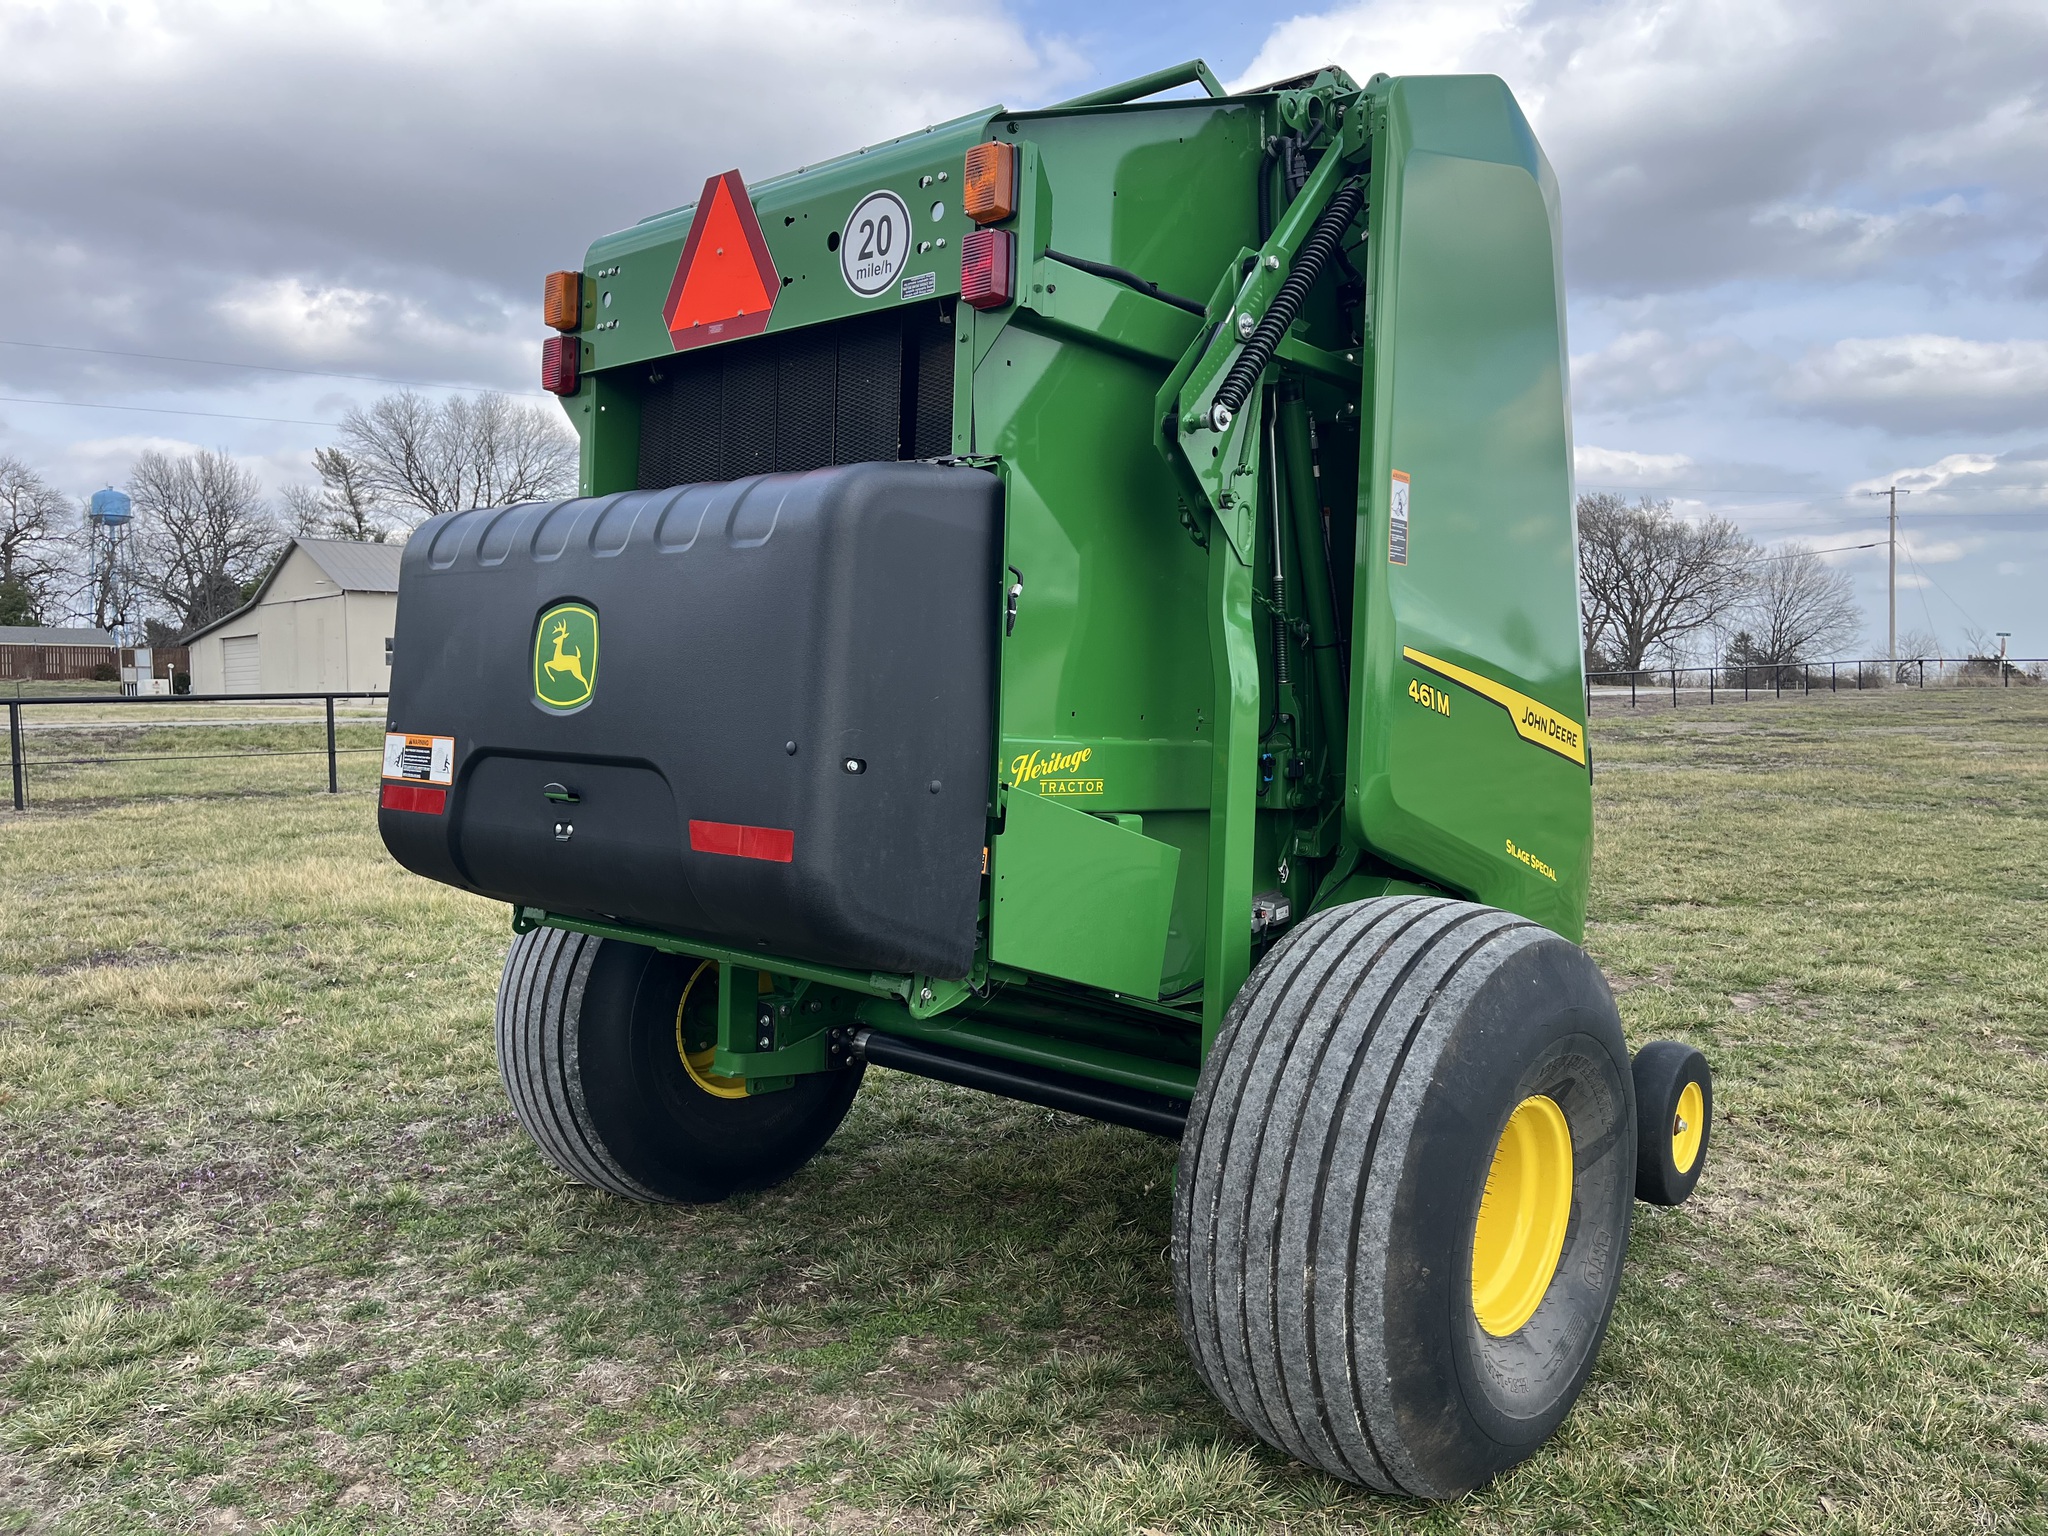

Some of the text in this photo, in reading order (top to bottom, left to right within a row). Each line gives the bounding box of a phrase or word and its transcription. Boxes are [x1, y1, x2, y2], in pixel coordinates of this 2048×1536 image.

[858, 214, 892, 261] 20
[856, 260, 892, 280] mile/h
[1408, 678, 1450, 718] 461M
[1521, 706, 1578, 748] JOHN DEERE
[1009, 747, 1092, 788] Heritage
[1040, 781, 1104, 793] TRACTOR
[1506, 838, 1557, 882] SILAGE SPECIAL
